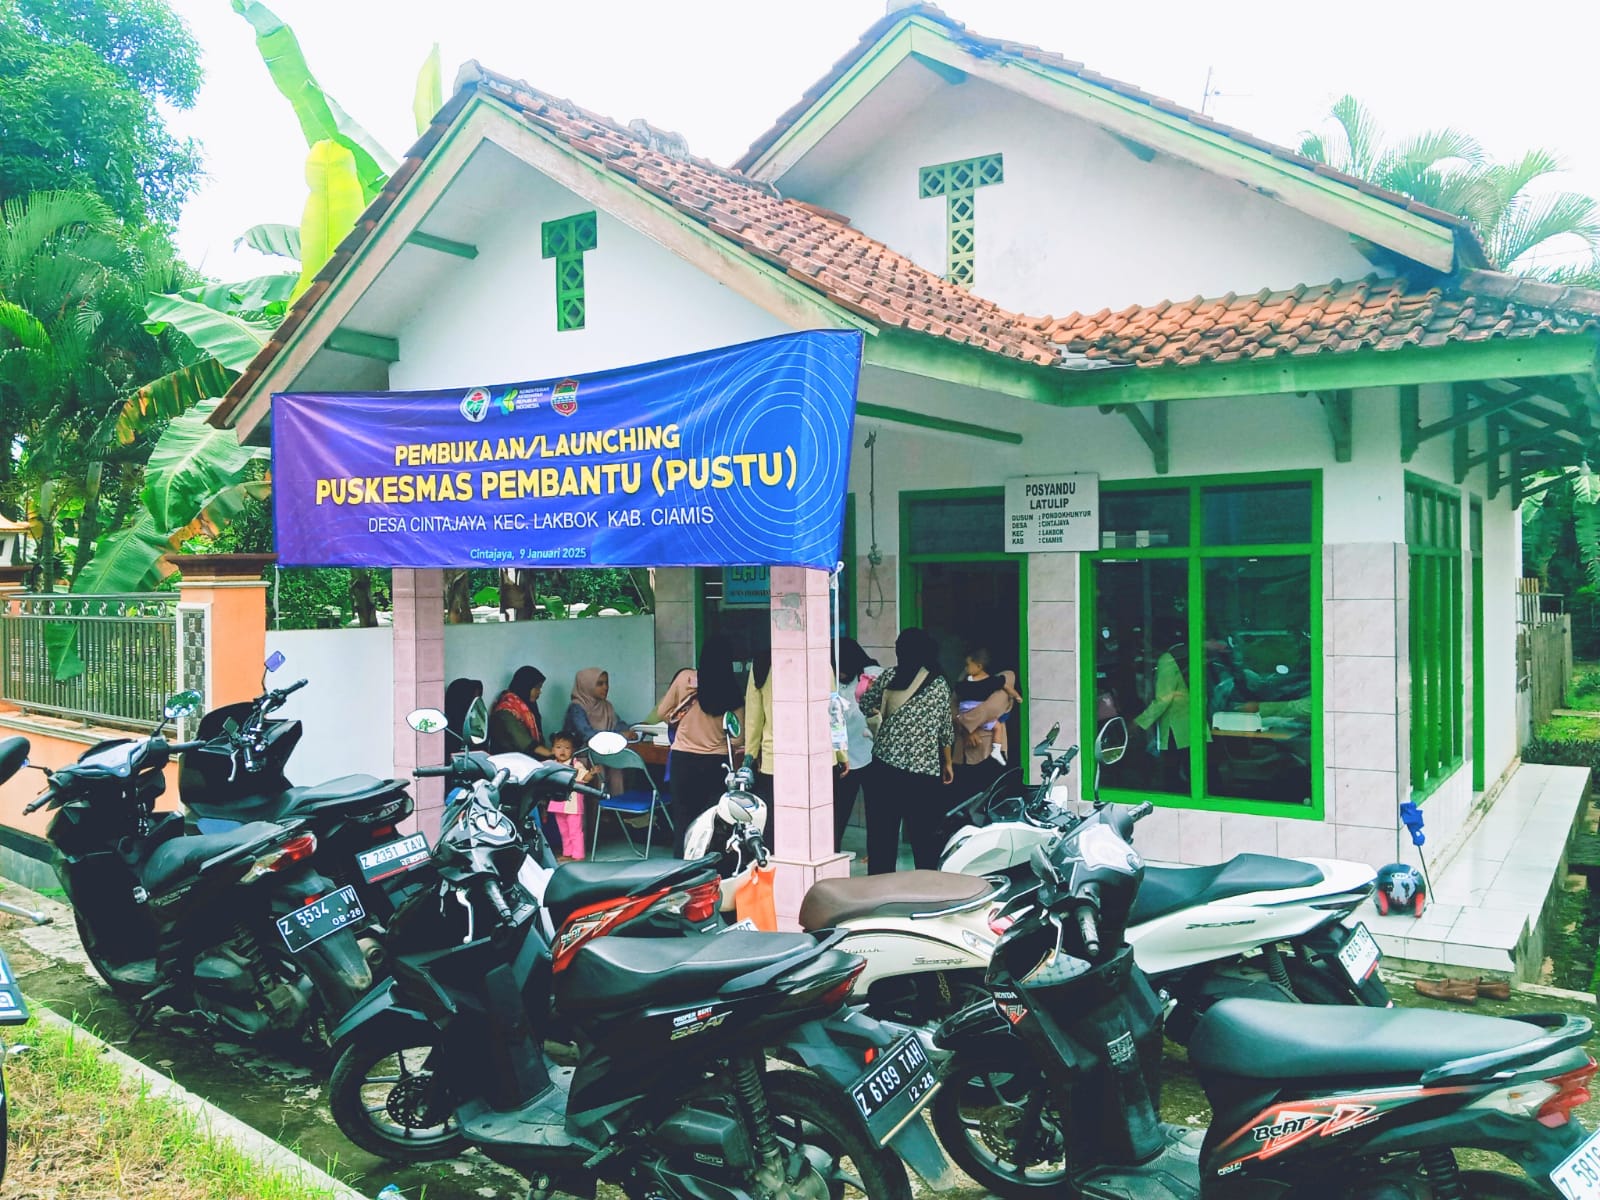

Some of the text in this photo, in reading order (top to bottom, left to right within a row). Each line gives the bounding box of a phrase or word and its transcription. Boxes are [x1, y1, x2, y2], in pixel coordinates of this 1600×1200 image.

[394, 423, 682, 467] PEMBUKAAN/LAUNCHING
[315, 444, 797, 506] PUSKESMAS PEMBANTU (PUSTU)
[1025, 482, 1076, 497] POSYANDU
[368, 506, 715, 533] DESA CINTAJAYA KEC. LAKBOK KAB. CIAMIS
[1030, 498, 1070, 510] LATULIP
[470, 547, 587, 561] Cintajaya, 9 Januari 2025
[280, 920, 294, 936] Z
[295, 901, 330, 926] 5534
[856, 1042, 924, 1116] Z 6199 TAH
